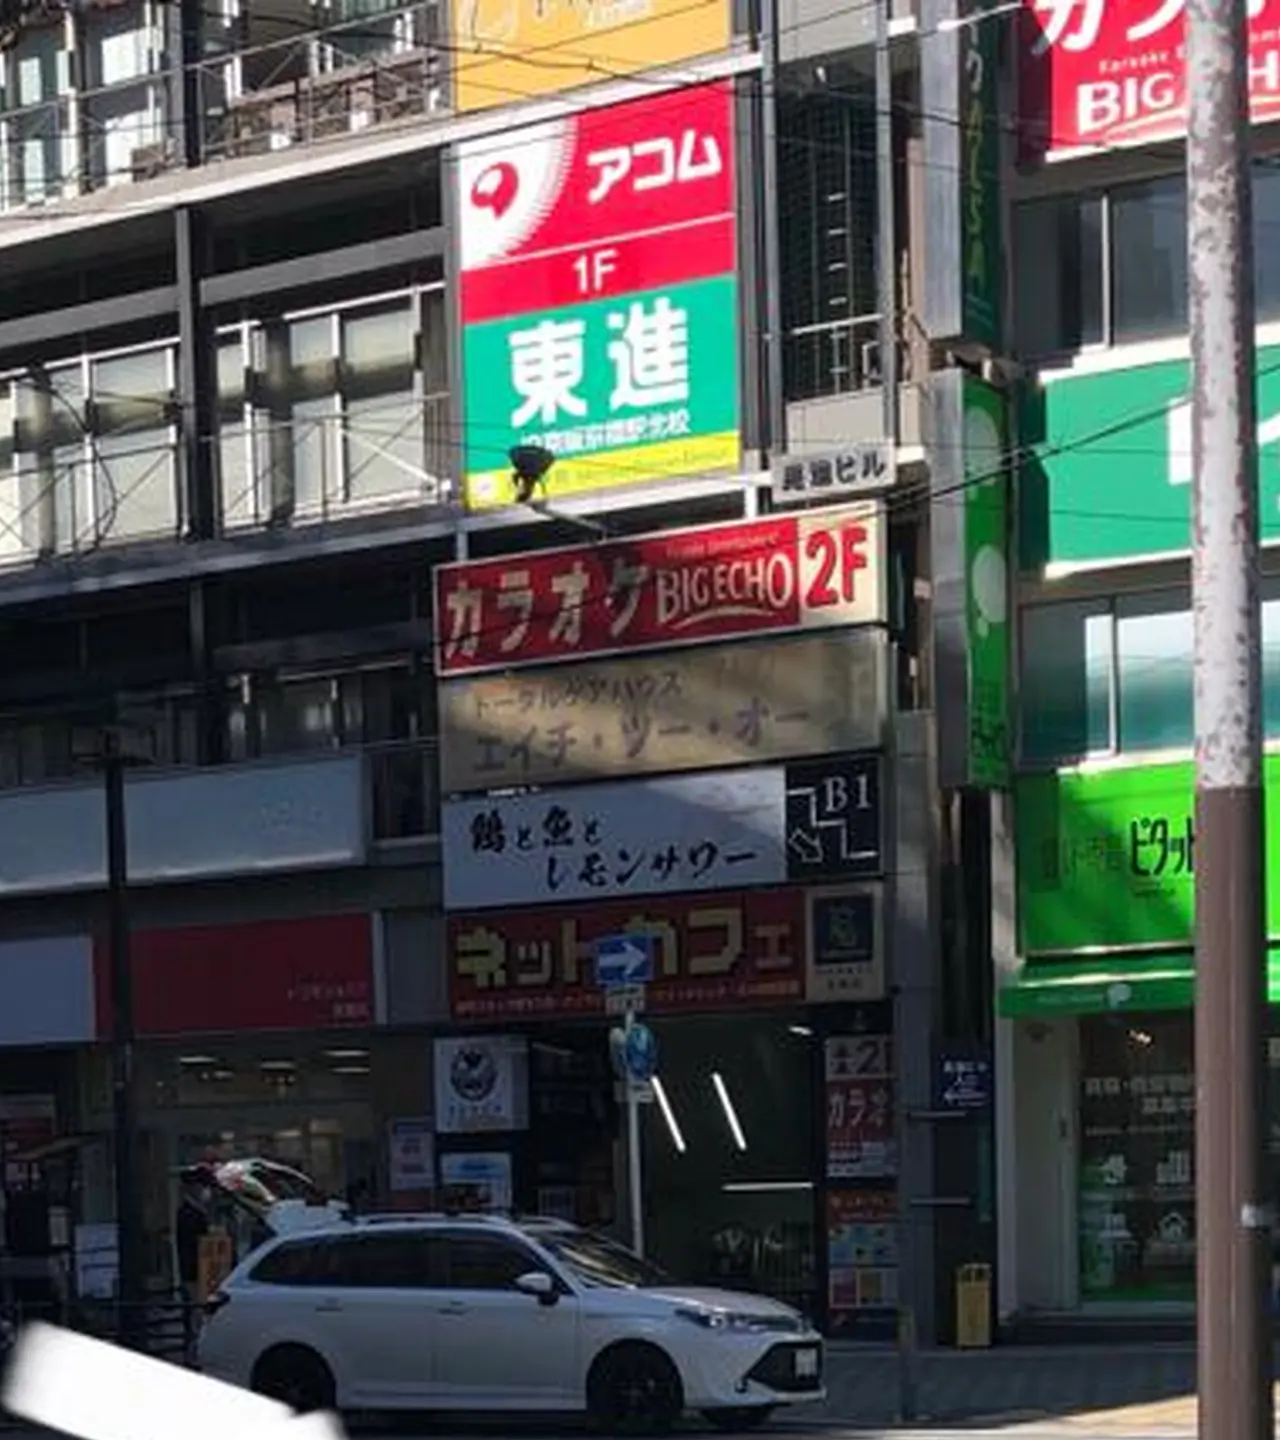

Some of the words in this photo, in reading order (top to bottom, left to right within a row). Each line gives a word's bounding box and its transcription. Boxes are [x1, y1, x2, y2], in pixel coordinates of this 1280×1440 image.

[1076, 72, 1175, 135] BIG
[586, 128, 723, 207] アコム
[573, 249, 617, 293] 1F
[507, 297, 690, 429] 東進
[445, 556, 647, 660] カラオケ
[656, 564, 710, 624] BIG
[713, 553, 794, 607] ECHO
[805, 525, 869, 608] 2F
[825, 774, 871, 813] B1
[1130, 817, 1196, 876] ピタット
